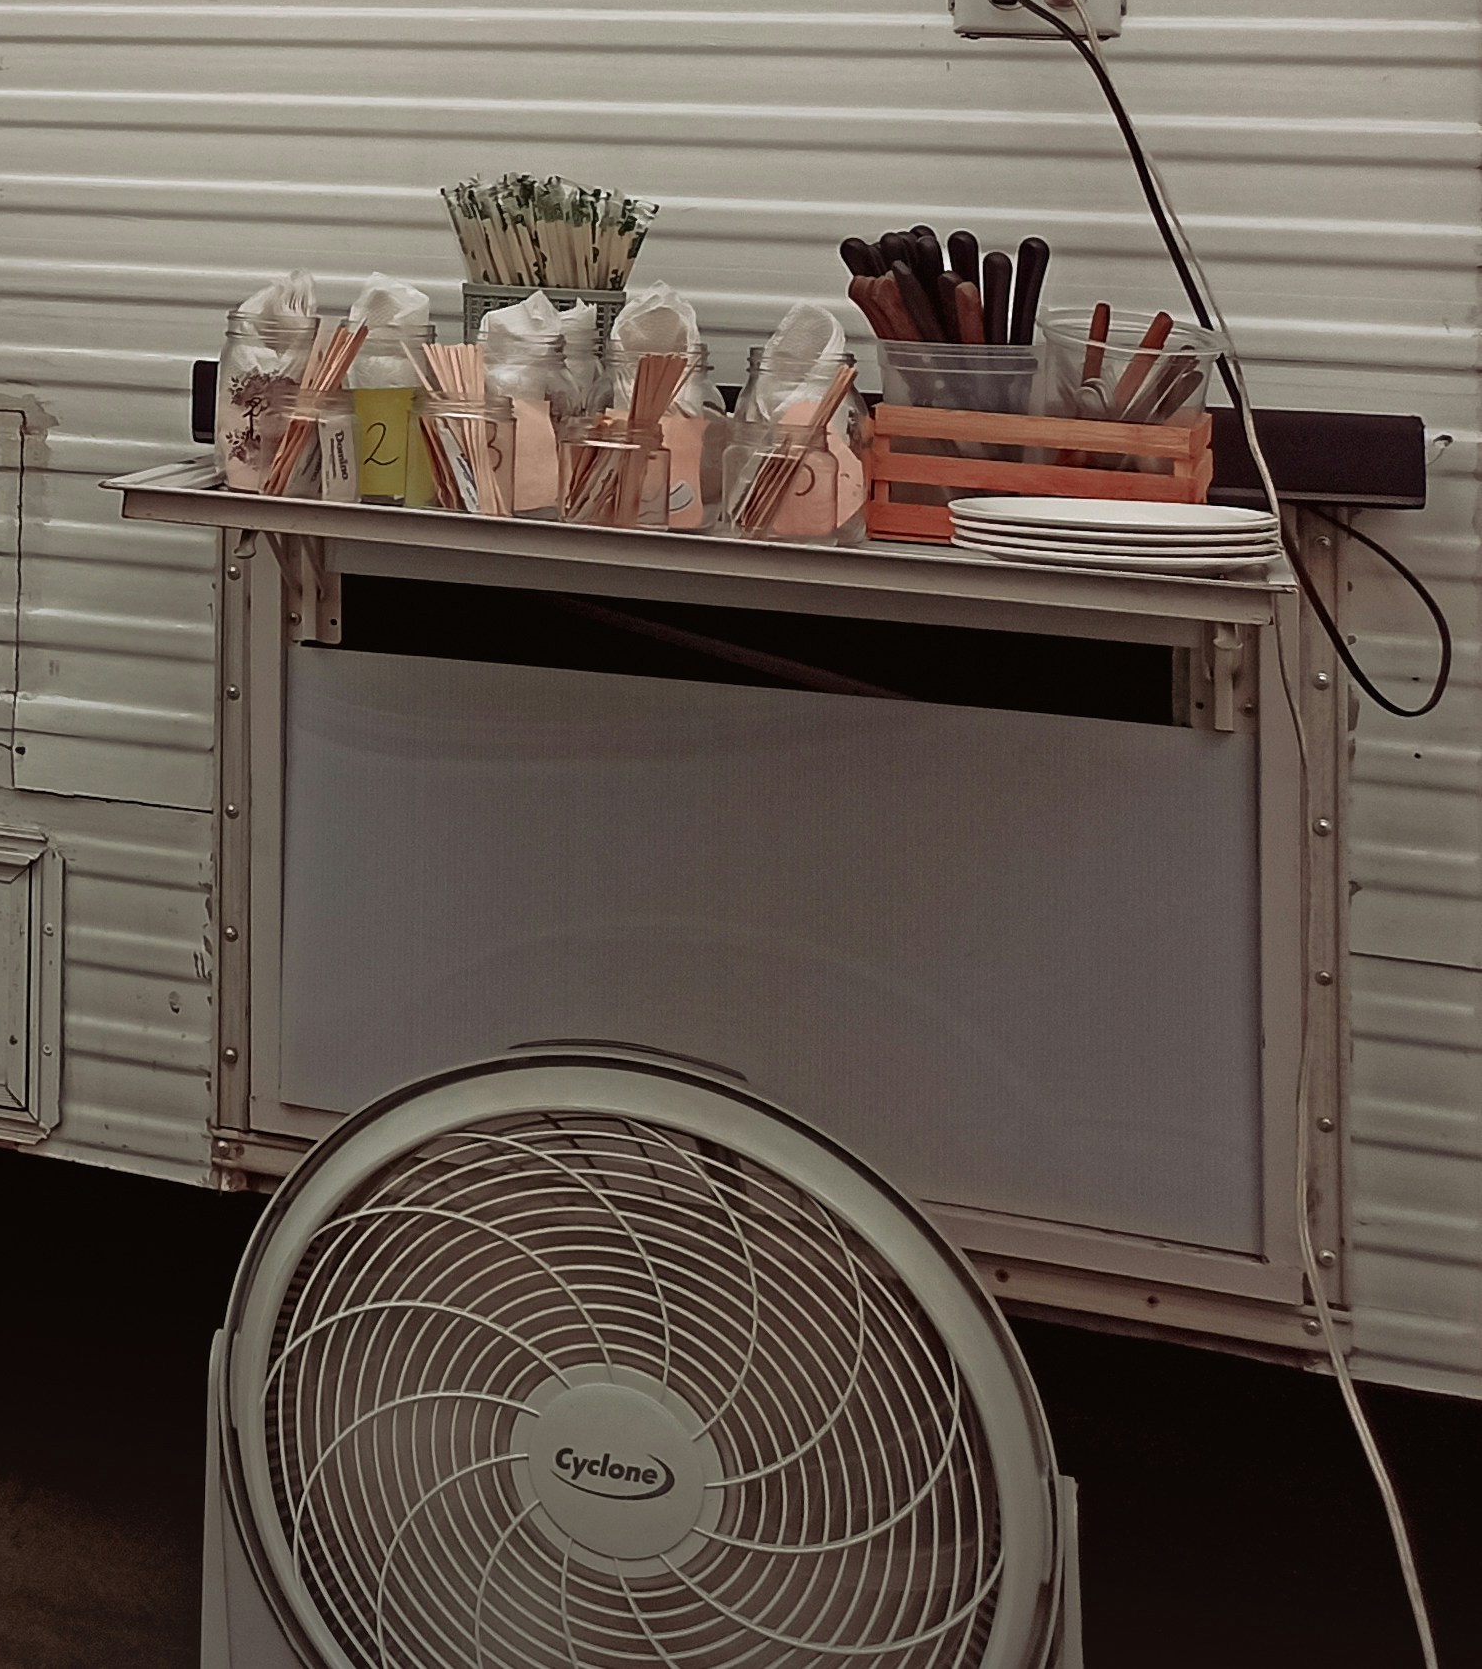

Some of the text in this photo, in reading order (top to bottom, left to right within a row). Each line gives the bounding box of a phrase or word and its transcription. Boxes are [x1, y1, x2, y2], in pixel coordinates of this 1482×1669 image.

[334, 429, 349, 482] Domino
[362, 421, 401, 467] 2
[554, 1447, 659, 1486] Cyclone
